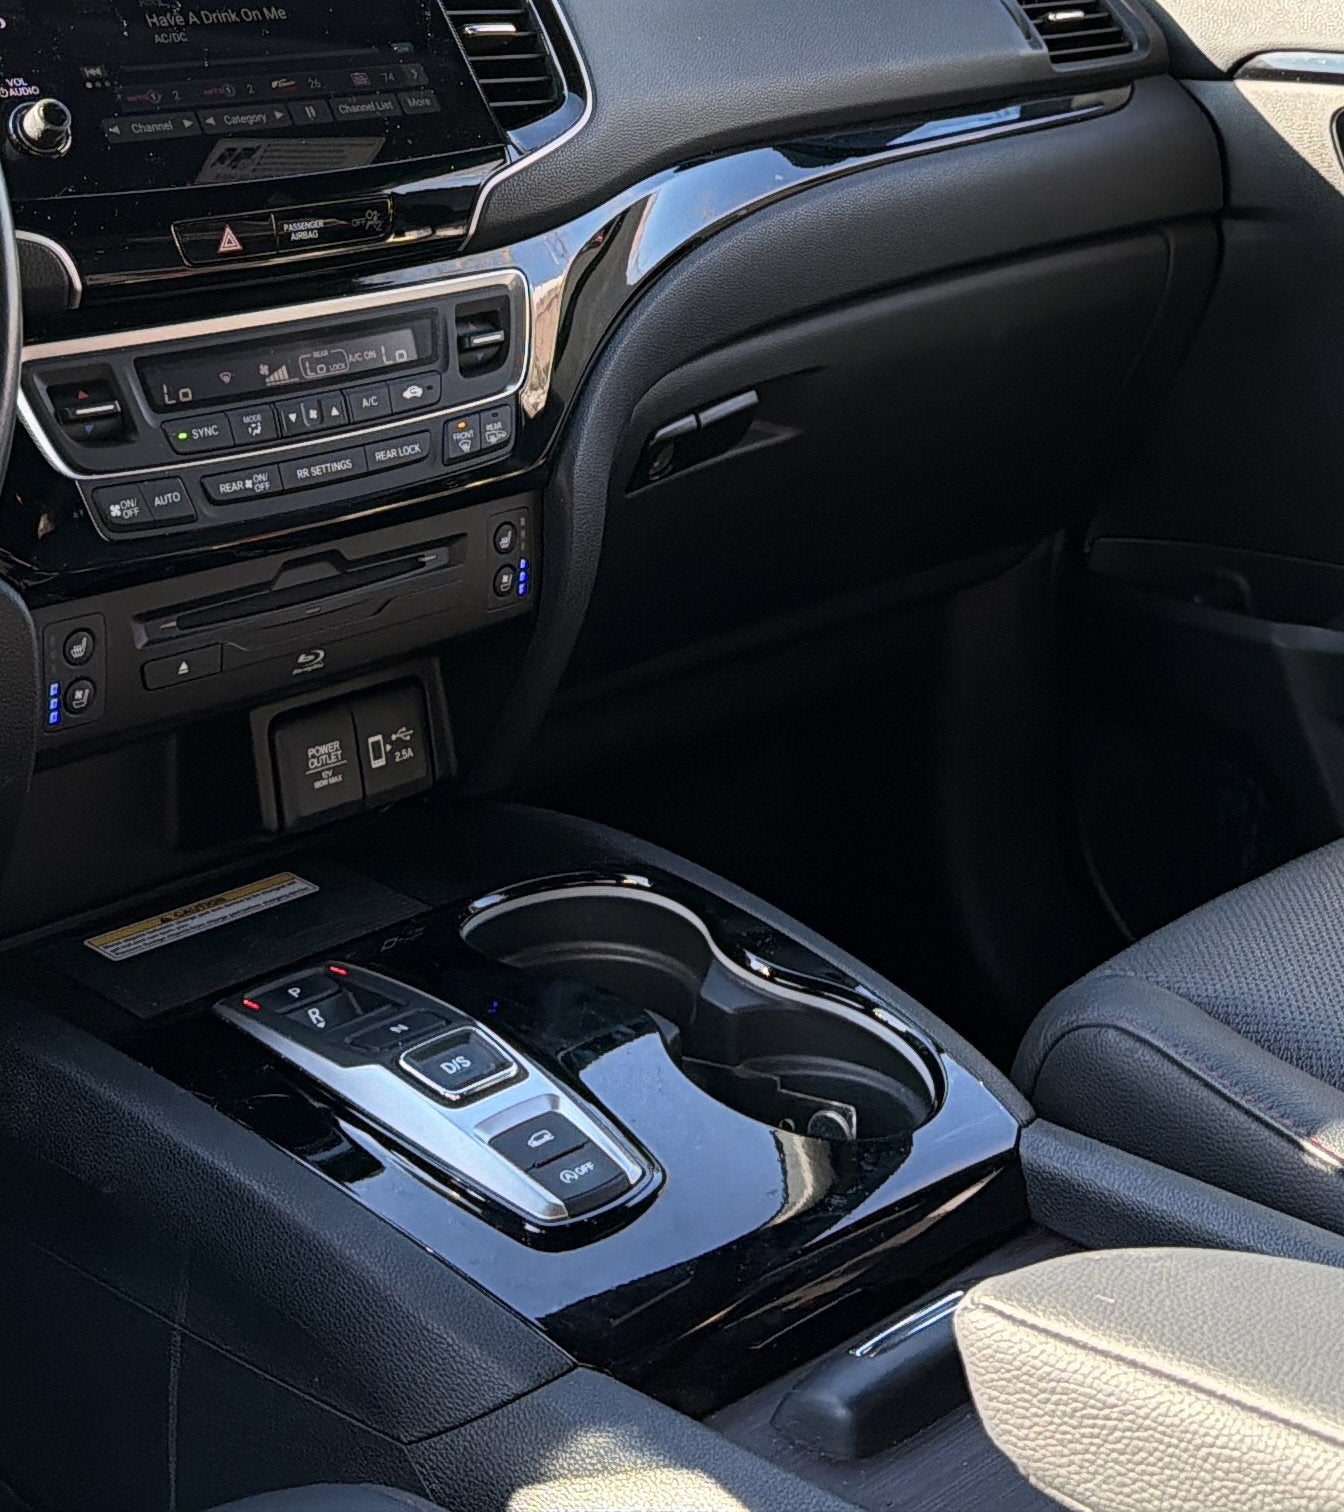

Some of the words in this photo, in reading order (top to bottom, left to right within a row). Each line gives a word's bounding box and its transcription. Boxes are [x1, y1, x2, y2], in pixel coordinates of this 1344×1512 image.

[145, 12, 185, 28] Have
[188, 11, 201, 25] A
[201, 8, 241, 24] Drink
[241, 7, 262, 21] On
[263, 5, 288, 20] Me
[154, 31, 189, 44] AC/DC
[6, 77, 29, 87] VOL
[382, 72, 396, 82] 74
[9, 86, 40, 97] AUDIO
[338, 101, 375, 114] Channel
[376, 100, 394, 111] List
[407, 97, 432, 108] More
[223, 113, 267, 126] Category
[131, 120, 174, 134] Channel
[283, 219, 324, 232] PASSENGER
[290, 229, 319, 241] AIRBAG
[364, 345, 377, 359] ON
[381, 345, 408, 365] Lo
[328, 362, 346, 372] LOCK
[163, 383, 193, 405] Lo
[362, 395, 379, 408] A/C
[243, 414, 263, 424] MODE
[191, 425, 219, 440] SYNC
[485, 421, 503, 432] REAR
[452, 431, 475, 442] FRONT
[375, 448, 397, 462] REAR
[398, 442, 422, 457] LOCK
[296, 467, 311, 480] RR
[311, 459, 353, 477] SETTINGS
[252, 472, 269, 484] ON/
[219, 479, 244, 494] REAR
[253, 481, 271, 493] OFF
[120, 497, 137, 511] ON/
[154, 491, 181, 508] AUTO
[122, 506, 140, 519] OFF
[307, 740, 341, 759] POWER
[395, 747, 414, 763] 2.5A
[308, 749, 343, 769] OUTLET
[329, 774, 343, 785] MAX
[287, 987, 301, 999] P
[307, 1008, 320, 1025] R
[389, 1022, 409, 1034] N
[440, 1055, 472, 1076] D/S
[573, 1161, 595, 1179] OFF
